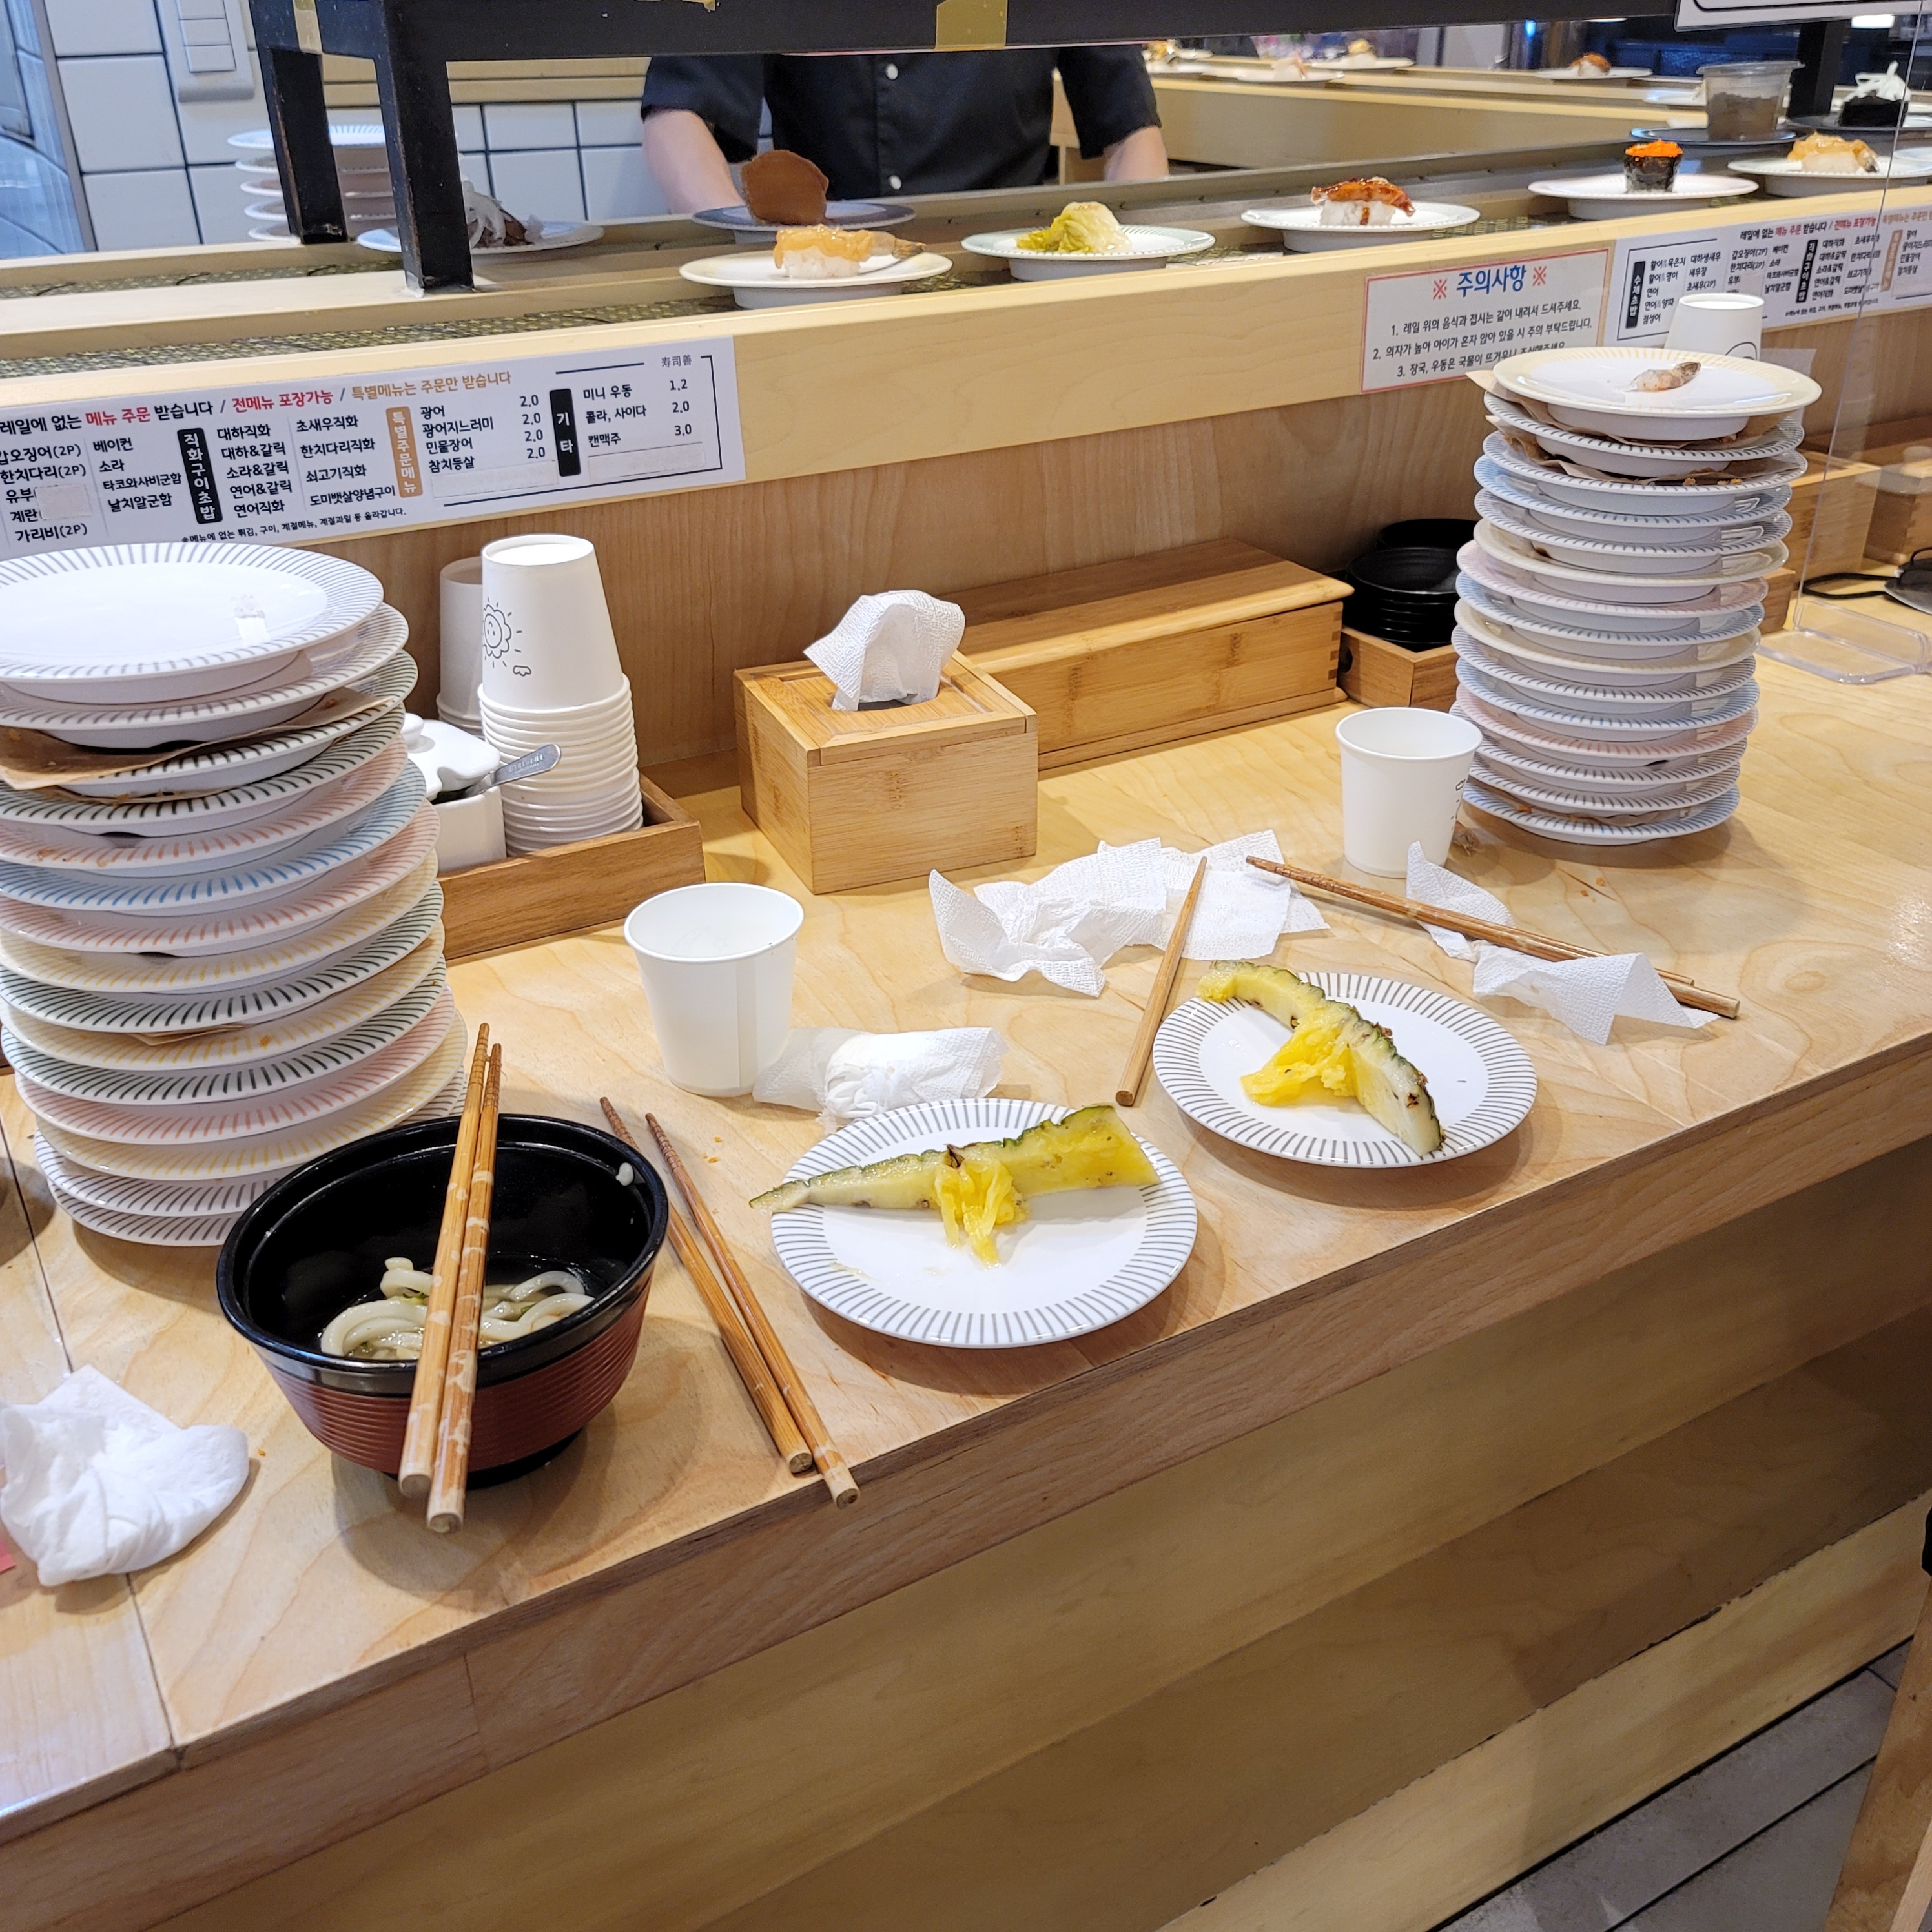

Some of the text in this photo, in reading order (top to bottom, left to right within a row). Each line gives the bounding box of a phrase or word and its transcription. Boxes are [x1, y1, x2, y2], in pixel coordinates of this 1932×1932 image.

[1456, 264, 1527, 298] 주의사항
[1647, 287, 1659, 298] 연어
[1392, 299, 1581, 336] 1. 레일 위의 음식과 접시는 같이 내려서 드셔주세요.
[1373, 348, 1381, 360] 2.
[1386, 344, 1412, 358] 의자가
[1415, 341, 1431, 355] 높아
[1434, 337, 1458, 351] 아이가
[1461, 334, 1477, 348] 혼자
[1499, 329, 1514, 342] 있을
[1517, 327, 1525, 338] 시
[1527, 324, 1543, 338] 주의
[1545, 318, 1592, 335] 부탁드립니다.
[1397, 365, 1406, 378] 3.
[1410, 362, 1428, 376] 장국,
[1431, 357, 1455, 372] 우동은
[1458, 354, 1483, 367] 국물이
[583, 378, 688, 400] 미니 우동 1.2
[0, 417, 48, 435] 레일에
[51, 414, 82, 431] 없는
[85, 411, 117, 426] 메뉴
[121, 407, 150, 423] 주문
[154, 401, 213, 421] 받습니다
[232, 396, 274, 413] 전메뉴
[278, 390, 333, 407] 포장가능
[351, 382, 416, 400] 특별메뉴는
[421, 377, 458, 393] 주문만
[462, 371, 511, 389] 받습니다
[420, 395, 539, 420] 광어 2.0
[586, 401, 690, 424] 콜라, 사이다 2.0
[217, 424, 271, 441] 대하직화
[296, 415, 358, 432] 초새우직화
[422, 413, 541, 438] 광어지느러미 2.0
[93, 437, 134, 452] 베이컨
[426, 429, 543, 455] 민물장어 2.0
[588, 424, 692, 447] 캔맥주 3.0
[221, 442, 286, 460] 대하&갈릭
[300, 438, 376, 459] 한치다리직화
[99, 458, 125, 472] 소라
[227, 460, 289, 478] 소라&갈릭
[429, 446, 546, 473] 참치등살 2.0
[0, 464, 86, 484] 한치다리(2P)
[103, 472, 181, 491] 타코와사비군함
[183, 433, 216, 520] 직화구이초밥
[306, 464, 367, 482] 쇠고기직화
[229, 479, 292, 499] 연어&갈릭
[310, 485, 396, 506] 도미뱃살양념구이
[108, 493, 172, 512] 날치알군함
[234, 499, 285, 518] 연어직화
[15, 523, 88, 543] 가리비(2P)
[218, 530, 235, 540] 없는
[260, 524, 280, 535] 구이,
